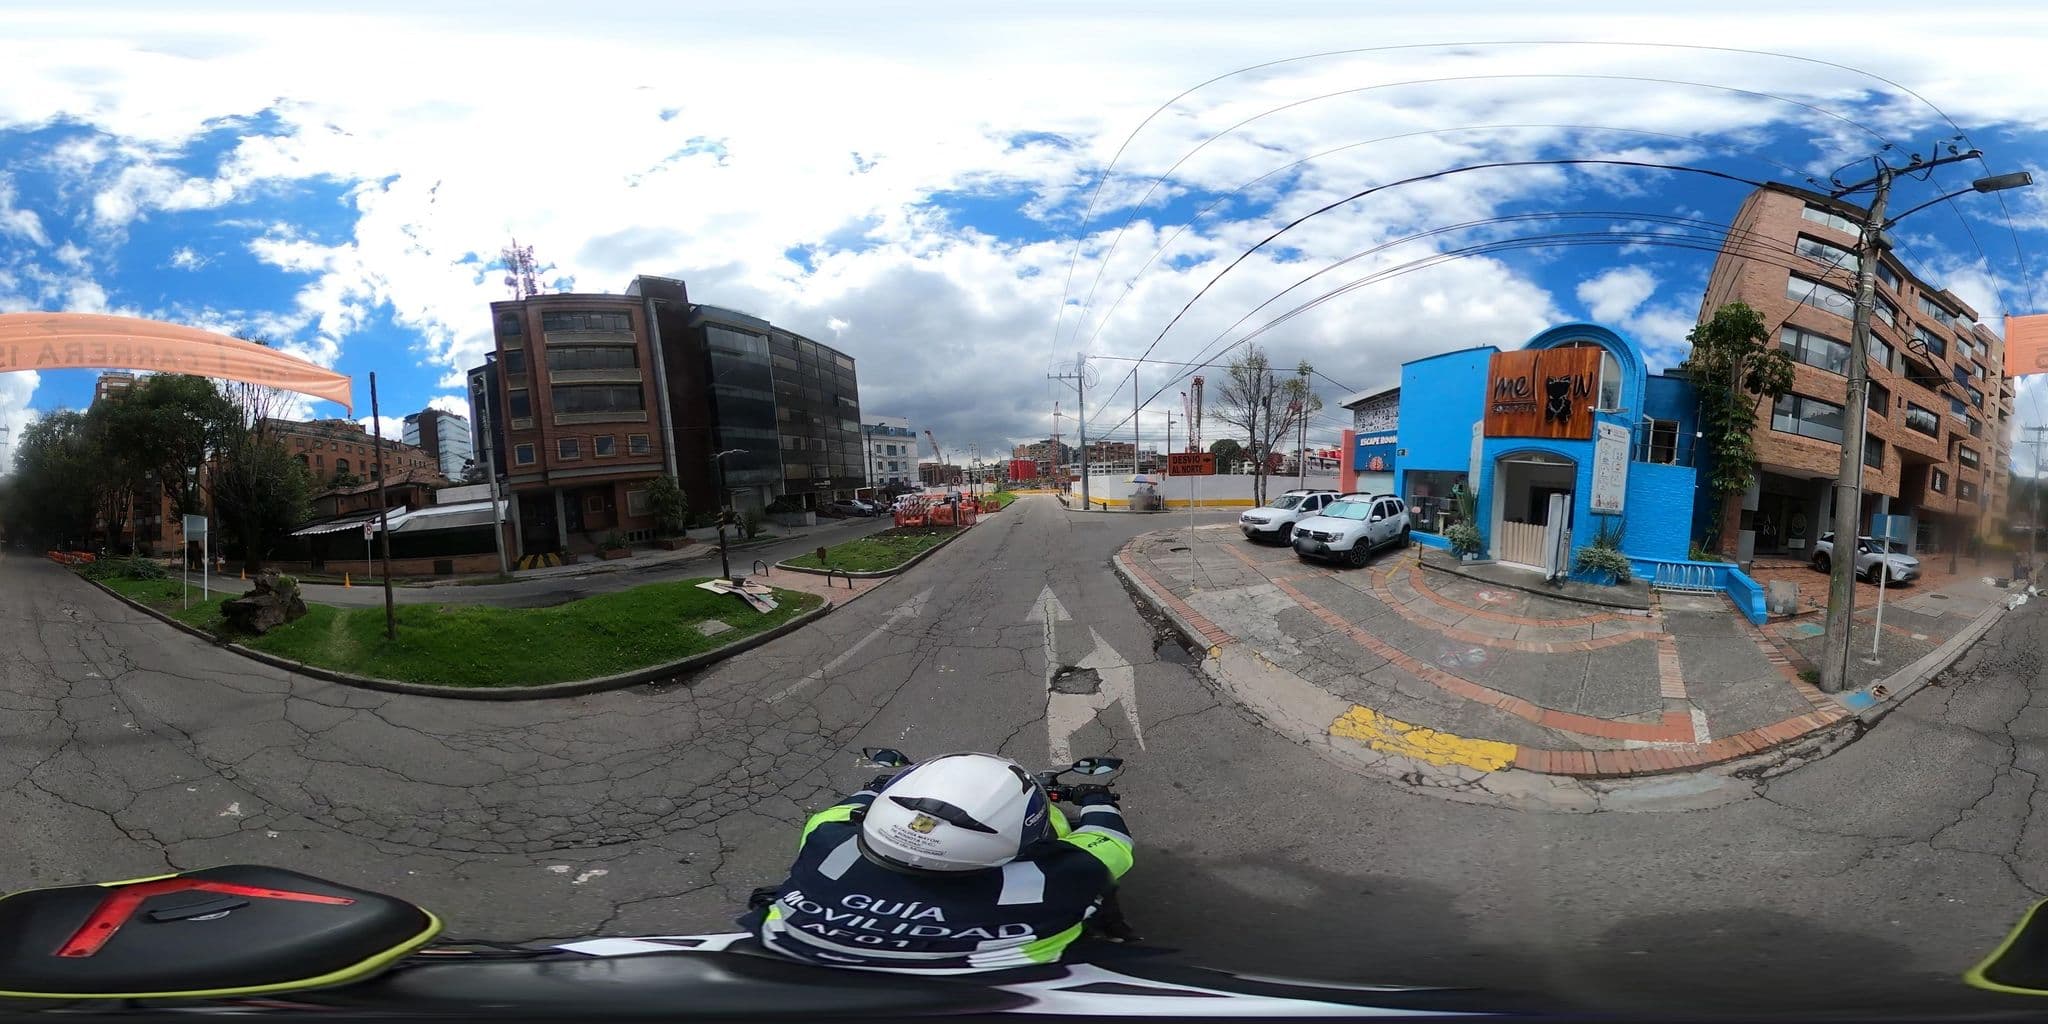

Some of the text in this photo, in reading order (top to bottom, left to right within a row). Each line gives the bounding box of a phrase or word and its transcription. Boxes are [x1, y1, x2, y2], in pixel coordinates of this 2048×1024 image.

[1360, 437, 1379, 446] ESCAPE
[1172, 455, 1200, 464] DESVIO
[1171, 464, 1203, 474] AL NORTE
[841, 894, 945, 922] GUÍA
[783, 890, 1034, 938] MOVILIDAD
